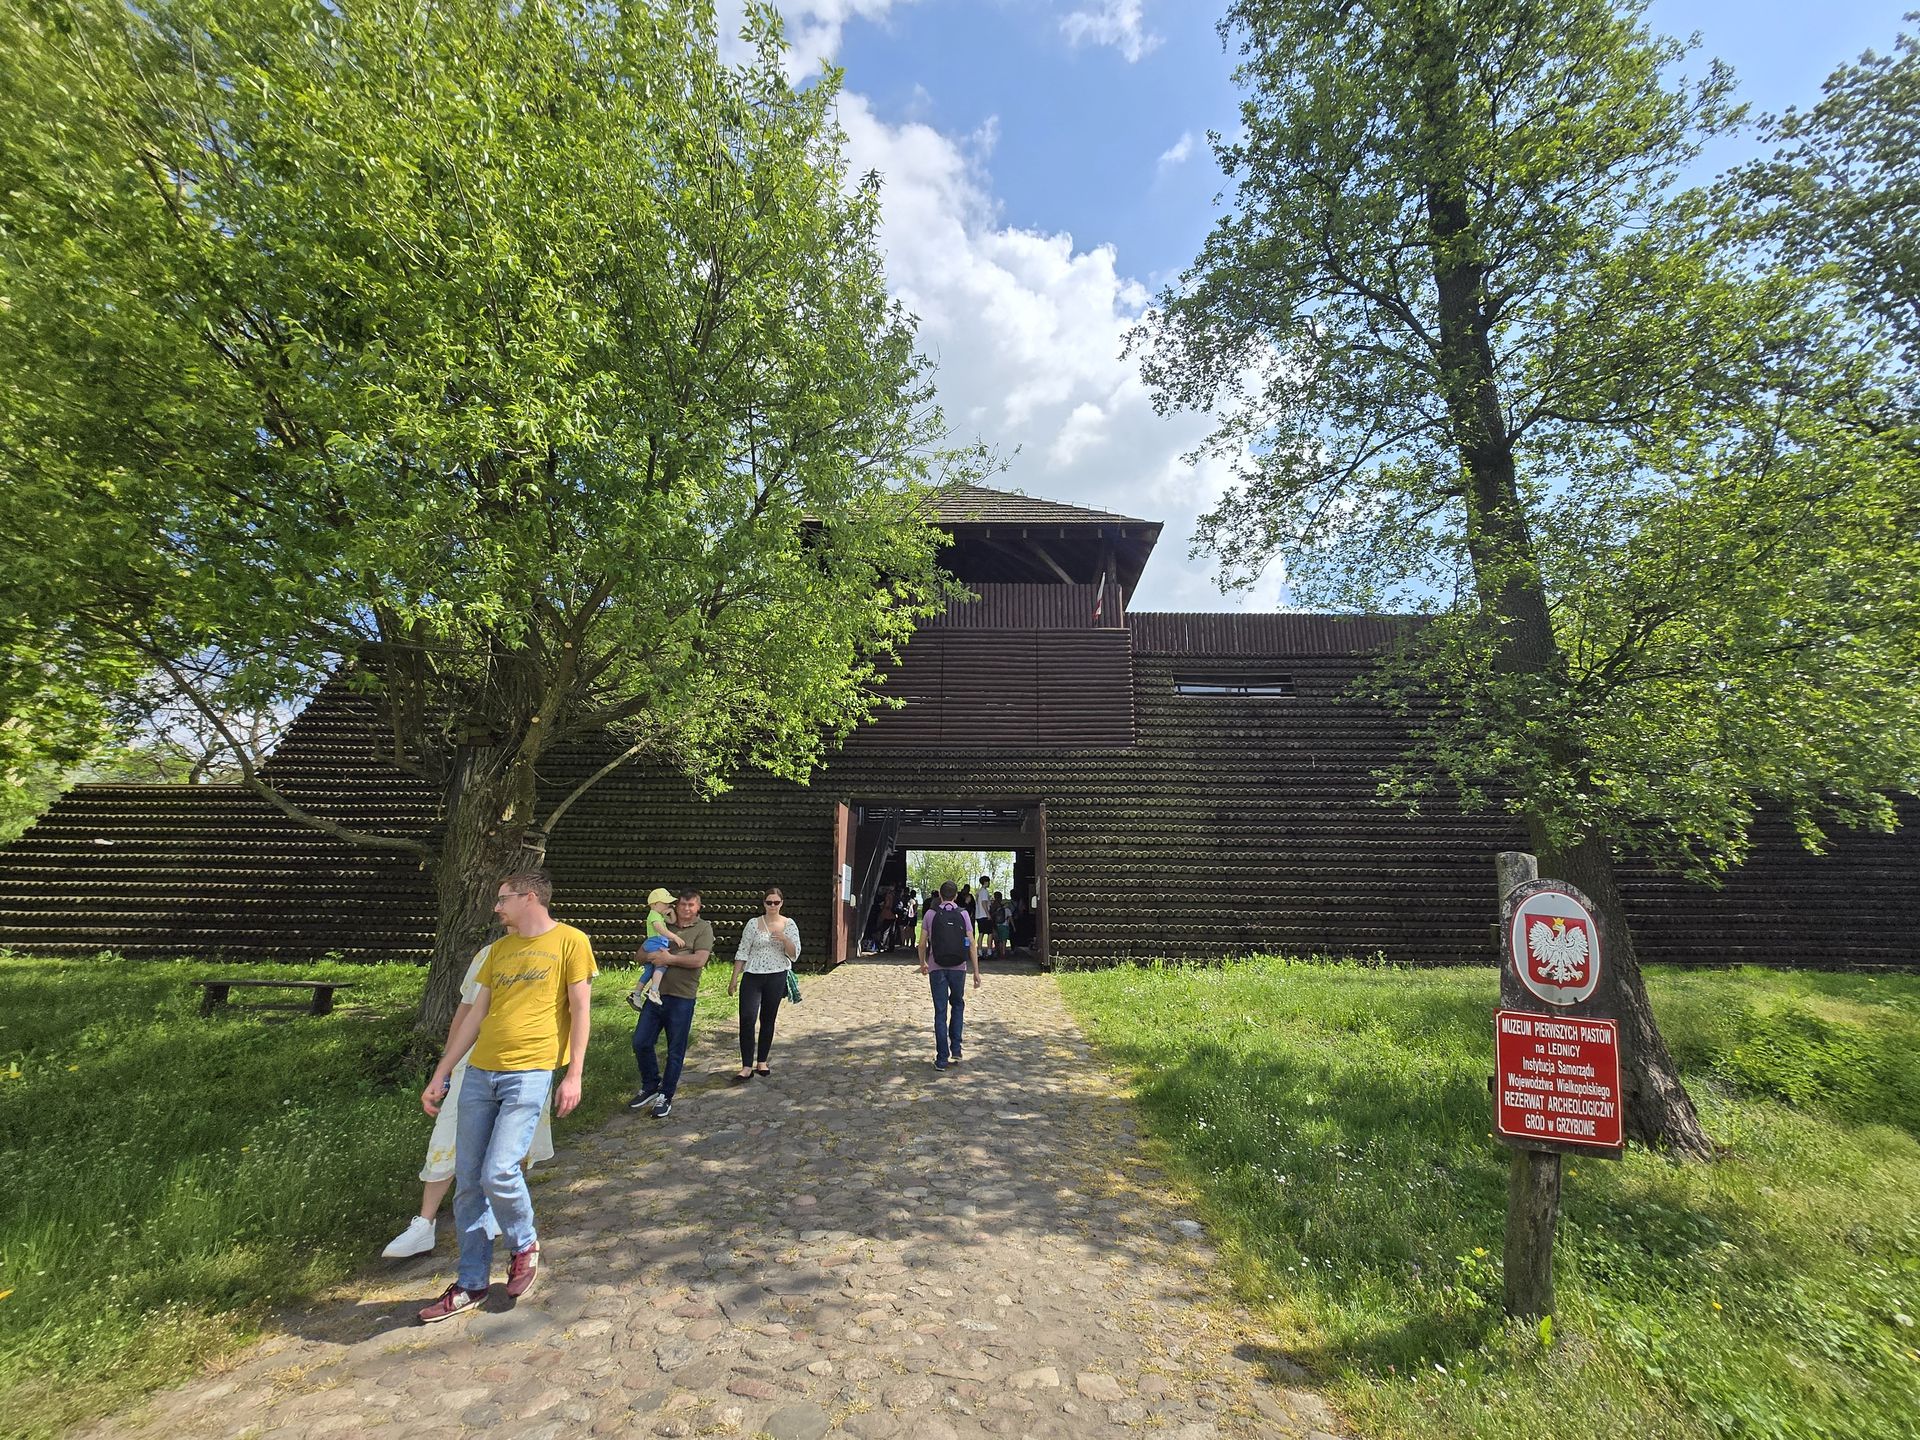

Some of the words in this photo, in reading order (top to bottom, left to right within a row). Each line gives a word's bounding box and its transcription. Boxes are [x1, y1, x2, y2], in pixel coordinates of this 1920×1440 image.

[1502, 1018, 1532, 1036] MUZEUM
[1534, 1021, 1578, 1041] PIERWSZYCH
[1580, 1025, 1611, 1044] PIASTÓW
[1535, 1044, 1545, 1054] na
[1548, 1043, 1581, 1058] LEDNICY
[1522, 1056, 1555, 1076] Instytucja
[1557, 1060, 1595, 1080] Samorządu
[1508, 1073, 1553, 1091] Województwa
[1556, 1078, 1611, 1100] Wielkopolskiego
[1504, 1091, 1544, 1110] REZERWAT
[1547, 1096, 1615, 1118] ARCHEOLOGICZNY
[1525, 1111, 1545, 1131] GRÓD
[1548, 1121, 1554, 1132] w
[1556, 1117, 1596, 1136] GRZYBOWIE
